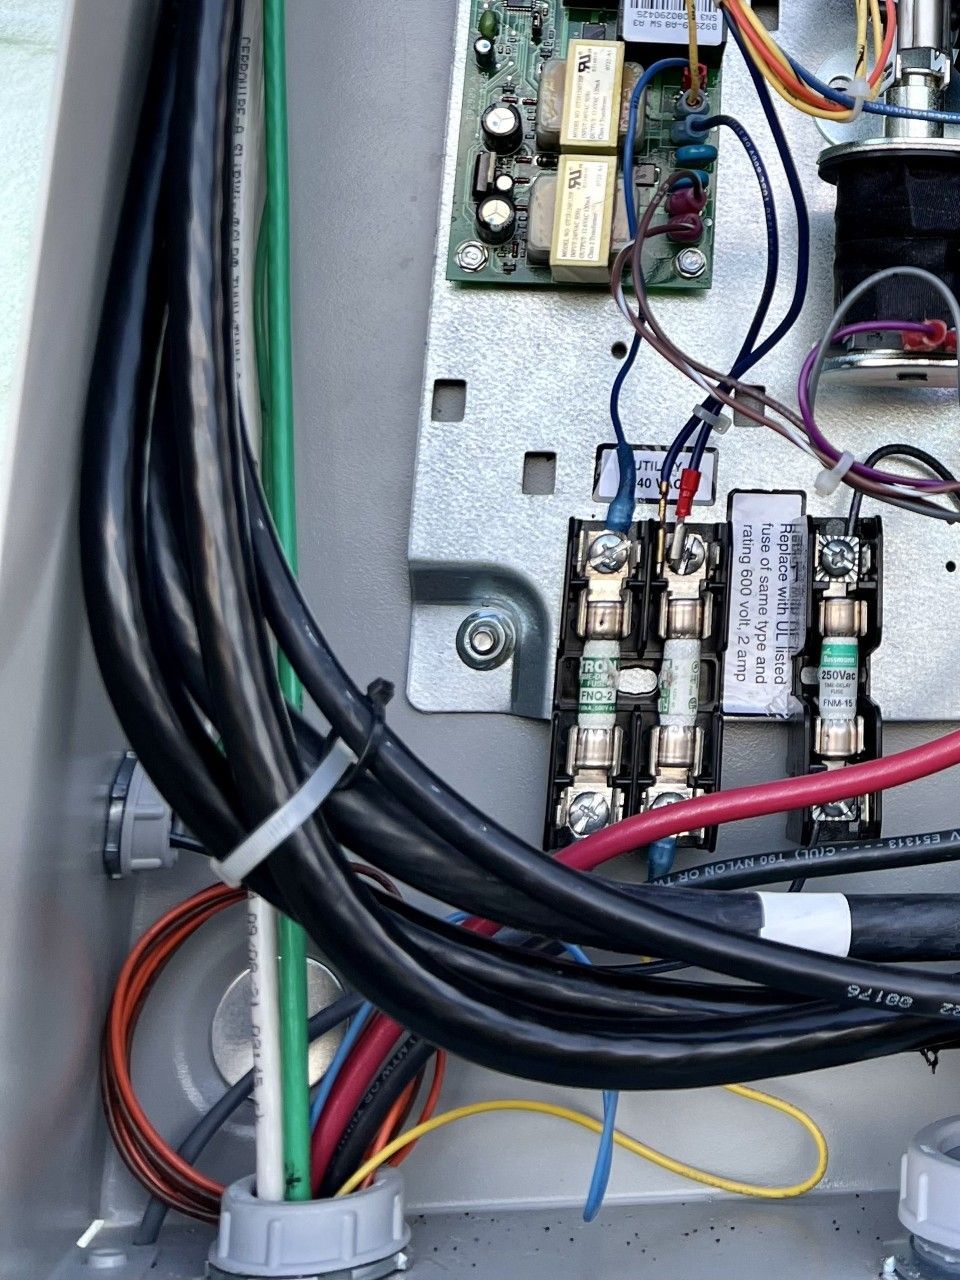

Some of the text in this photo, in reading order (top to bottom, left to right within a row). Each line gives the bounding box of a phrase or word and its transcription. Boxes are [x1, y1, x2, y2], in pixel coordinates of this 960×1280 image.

[736, 524, 755, 682] rating 600 volt, 2 amp
[755, 523, 774, 684] fuse of same type and
[774, 523, 793, 685] Replace with UL listed
[821, 670, 856, 680] 250Vac
[823, 699, 853, 707] FNM-15
[888, 834, 941, 849] E51313
[705, 858, 754, 878] NYLON
[760, 853, 786, 866] T90
[679, 872, 700, 883] OR
[847, 984, 914, 1009] 00176
